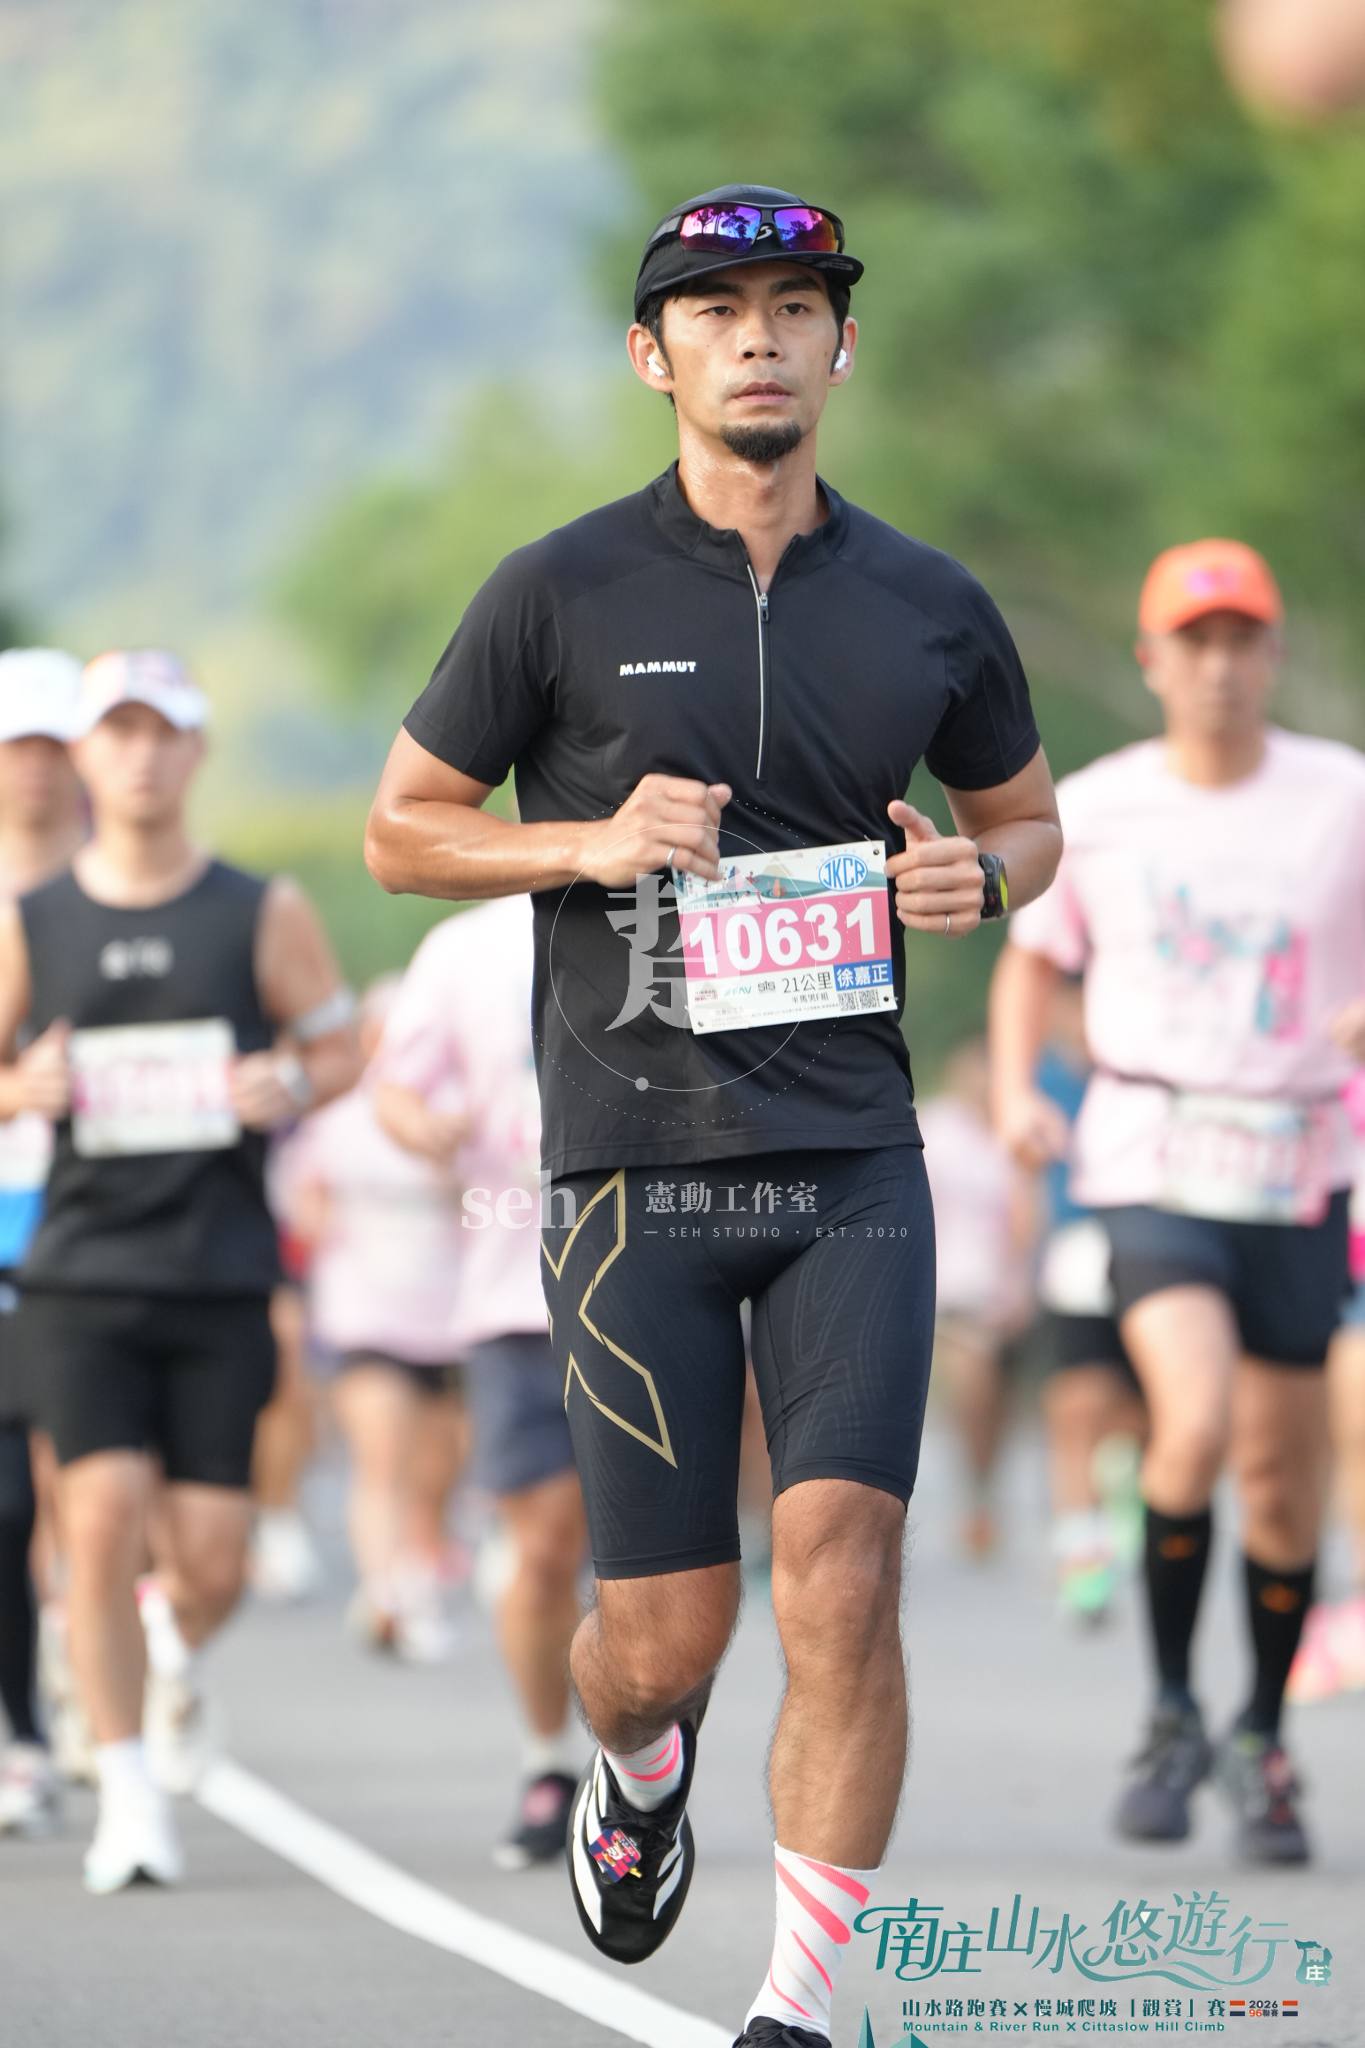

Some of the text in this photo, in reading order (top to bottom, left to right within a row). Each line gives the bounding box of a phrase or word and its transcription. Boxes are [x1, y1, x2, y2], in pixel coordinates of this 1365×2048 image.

[619, 660, 697, 677] MAMMUT
[823, 857, 866, 889] JKCR
[689, 898, 878, 976] 10631
[783, 971, 833, 994] 21公里
[837, 963, 889, 988] 徐嘉正
